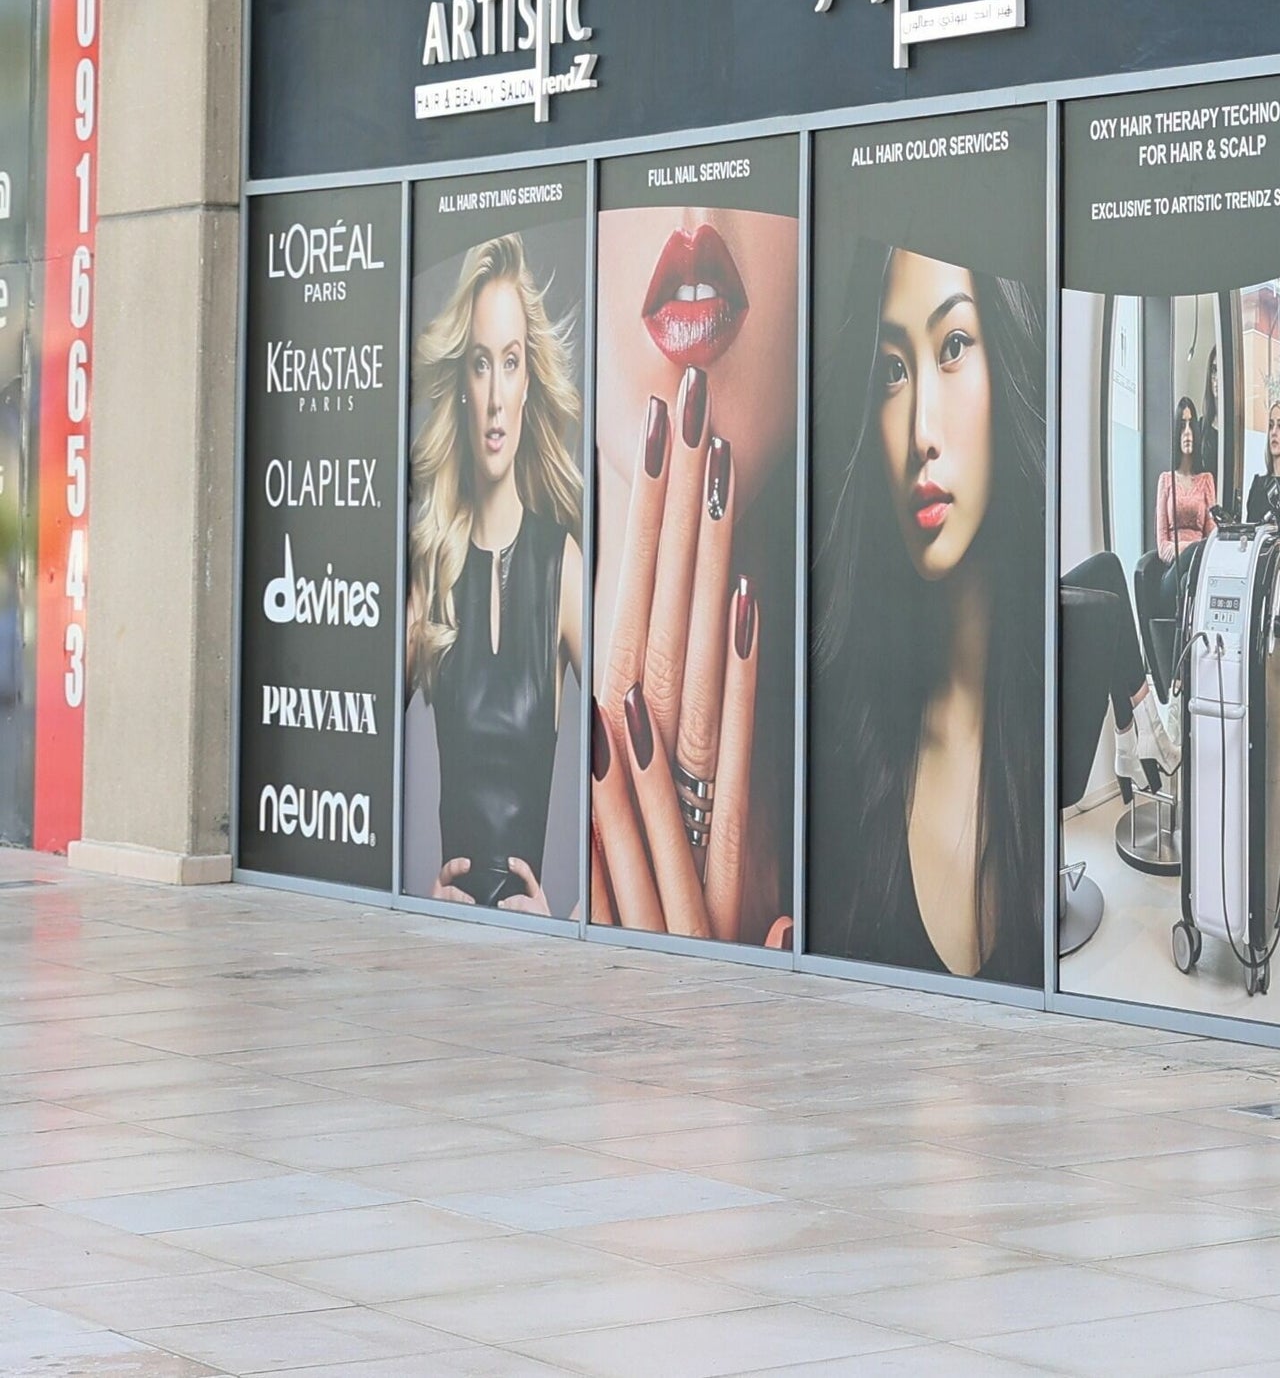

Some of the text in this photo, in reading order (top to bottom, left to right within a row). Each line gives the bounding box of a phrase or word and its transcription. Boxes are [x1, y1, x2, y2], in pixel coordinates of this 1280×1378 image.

[501, 79, 535, 101] SALON
[1090, 118, 1117, 140] OXY
[1121, 115, 1152, 137] HAIR
[1155, 108, 1219, 133] THERAPY
[852, 131, 1008, 166] ALL HAIR COLOR SERVICES
[1140, 135, 1266, 166] FOR HAIR & SCALP
[649, 159, 750, 186] FULL NAIL SERVICES
[439, 184, 562, 212] ALL HAIR STYLING SERVICES
[1092, 199, 1151, 220] EXCLUSIVE
[1154, 198, 1169, 214] TO
[1171, 194, 1222, 213] ARTISTIC
[1225, 190, 1271, 209] TRENDZ
[268, 341, 383, 392] KÉRASTASE
[300, 396, 353, 412] PARIS
[264, 534, 379, 627] davines
